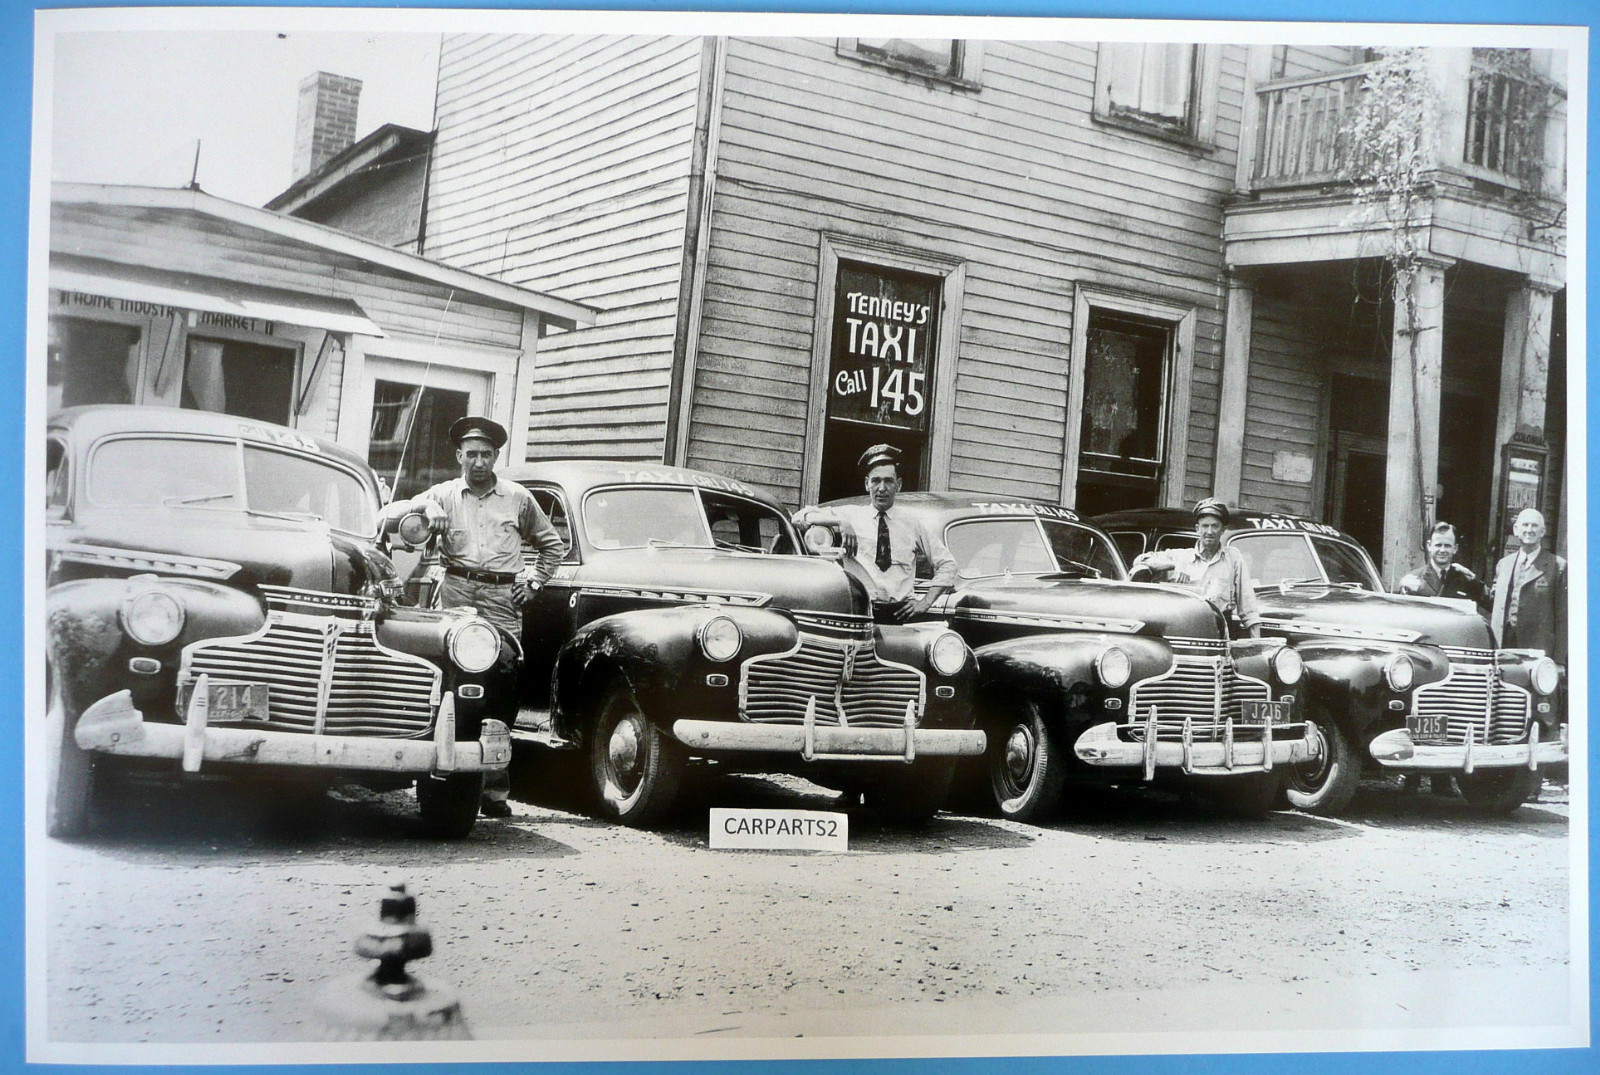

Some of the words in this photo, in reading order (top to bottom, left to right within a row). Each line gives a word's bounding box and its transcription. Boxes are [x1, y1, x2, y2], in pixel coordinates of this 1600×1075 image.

[74, 291, 115, 309] HOME
[120, 298, 174, 318] INDUSTR
[201, 311, 255, 331] MARKET
[847, 292, 930, 324] TENNEY'S
[846, 317, 916, 363] TAXI
[835, 370, 867, 395] Call
[870, 366, 925, 415] 145
[618, 470, 684, 483] TAXI
[722, 480, 755, 497] 145
[1246, 518, 1296, 530] TAXI
[569, 592, 578, 608] 6
[724, 817, 838, 837] CARPARTS2
